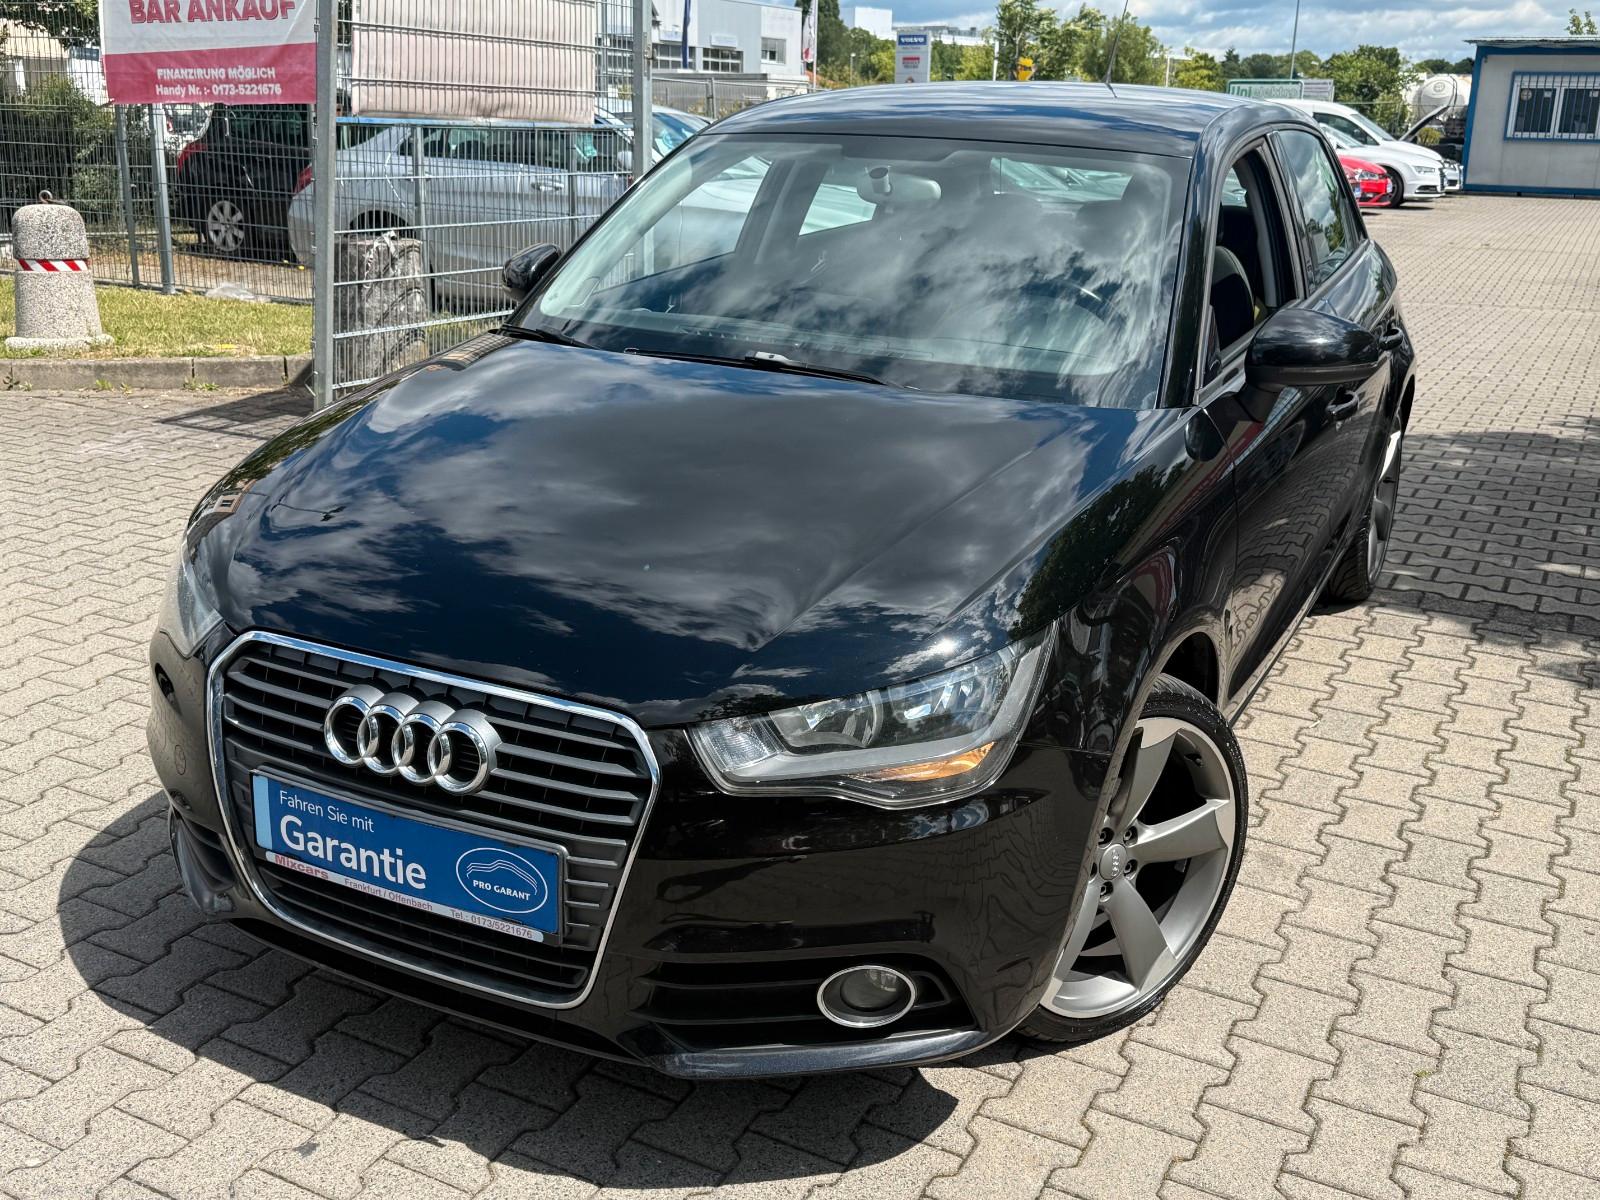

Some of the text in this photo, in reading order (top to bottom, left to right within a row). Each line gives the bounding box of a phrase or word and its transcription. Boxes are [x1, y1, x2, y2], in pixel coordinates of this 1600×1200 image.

[128, 0, 296, 24] BAR ANKAUF
[157, 65, 276, 80] FINANZIRUNG MÖGLICH
[155, 84, 186, 98] Handy
[211, 84, 282, 96] 0173-5221676
[280, 790, 374, 833] Fahren Sie mit
[280, 814, 427, 890] Garantie
[275, 854, 329, 880] Mixcars
[344, 878, 382, 897] Frankfurt
[388, 891, 433, 911] Offenbach
[473, 879, 530, 901] PRO GARANT
[470, 916, 533, 939] 0173/5221676
